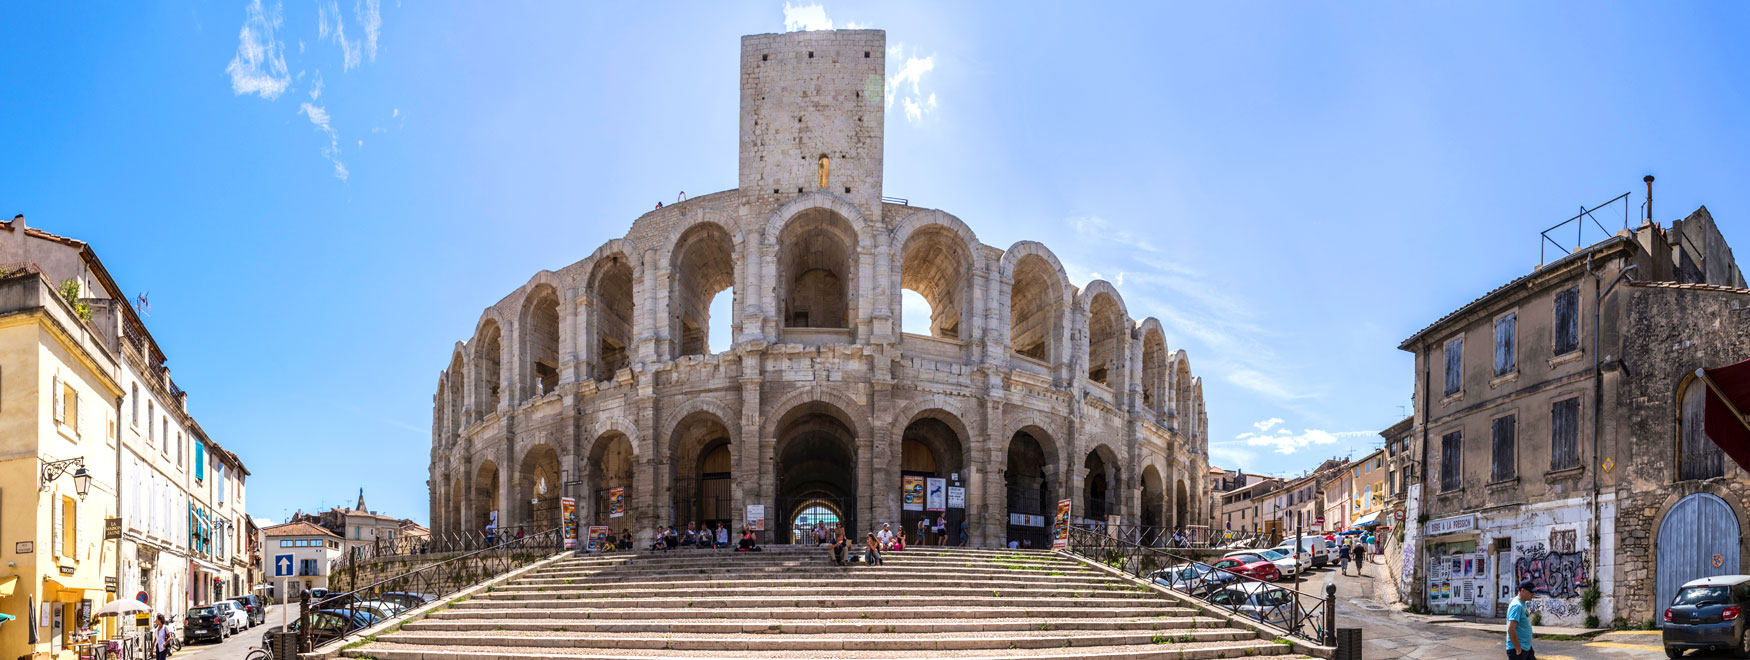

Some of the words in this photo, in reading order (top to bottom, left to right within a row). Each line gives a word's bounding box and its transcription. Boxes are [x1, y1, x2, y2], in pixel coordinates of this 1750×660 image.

[1446, 521, 1452, 530] LA
[1453, 518, 1471, 528] PRESSION
[1454, 586, 1461, 598] W
[1477, 586, 1484, 598] I
[1502, 586, 1510, 598] P
